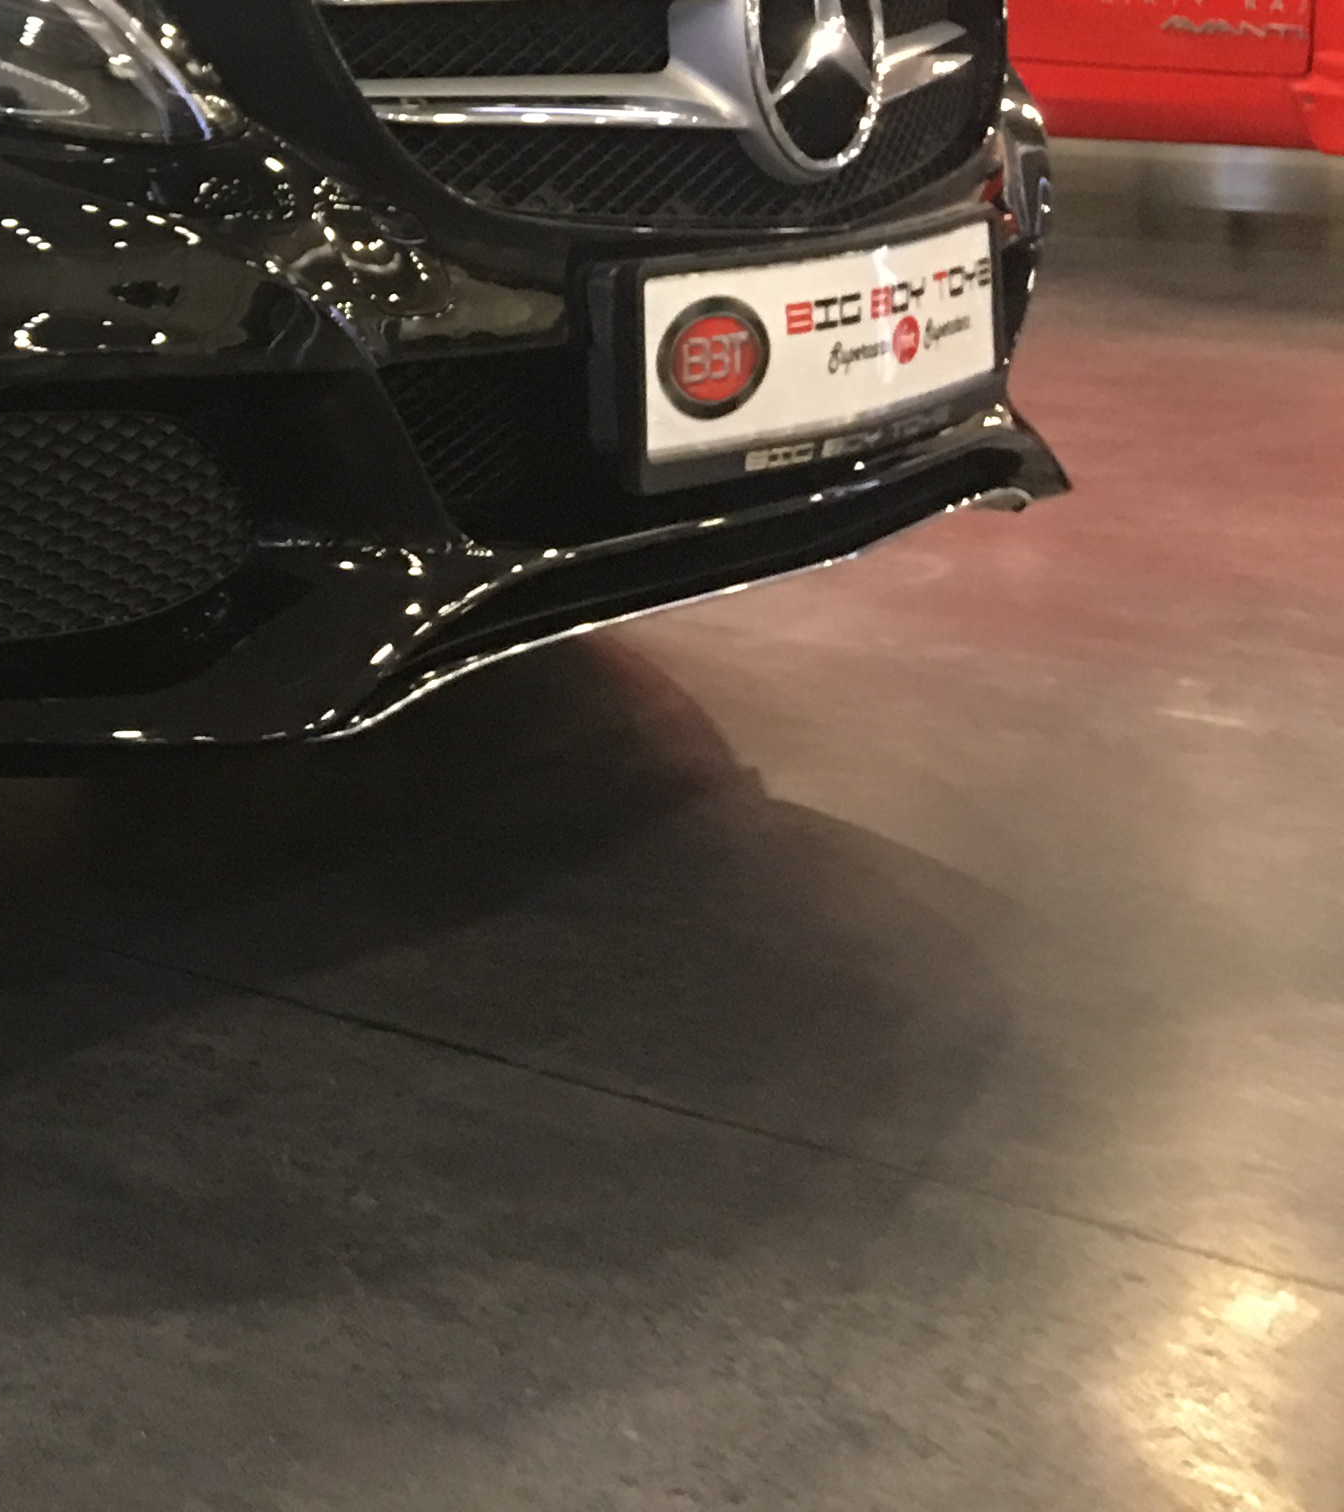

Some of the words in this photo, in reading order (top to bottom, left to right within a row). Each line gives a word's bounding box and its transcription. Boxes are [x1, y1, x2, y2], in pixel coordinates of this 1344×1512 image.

[785, 292, 862, 335] BIG
[870, 276, 925, 319] BOY
[682, 330, 748, 384] BBT
